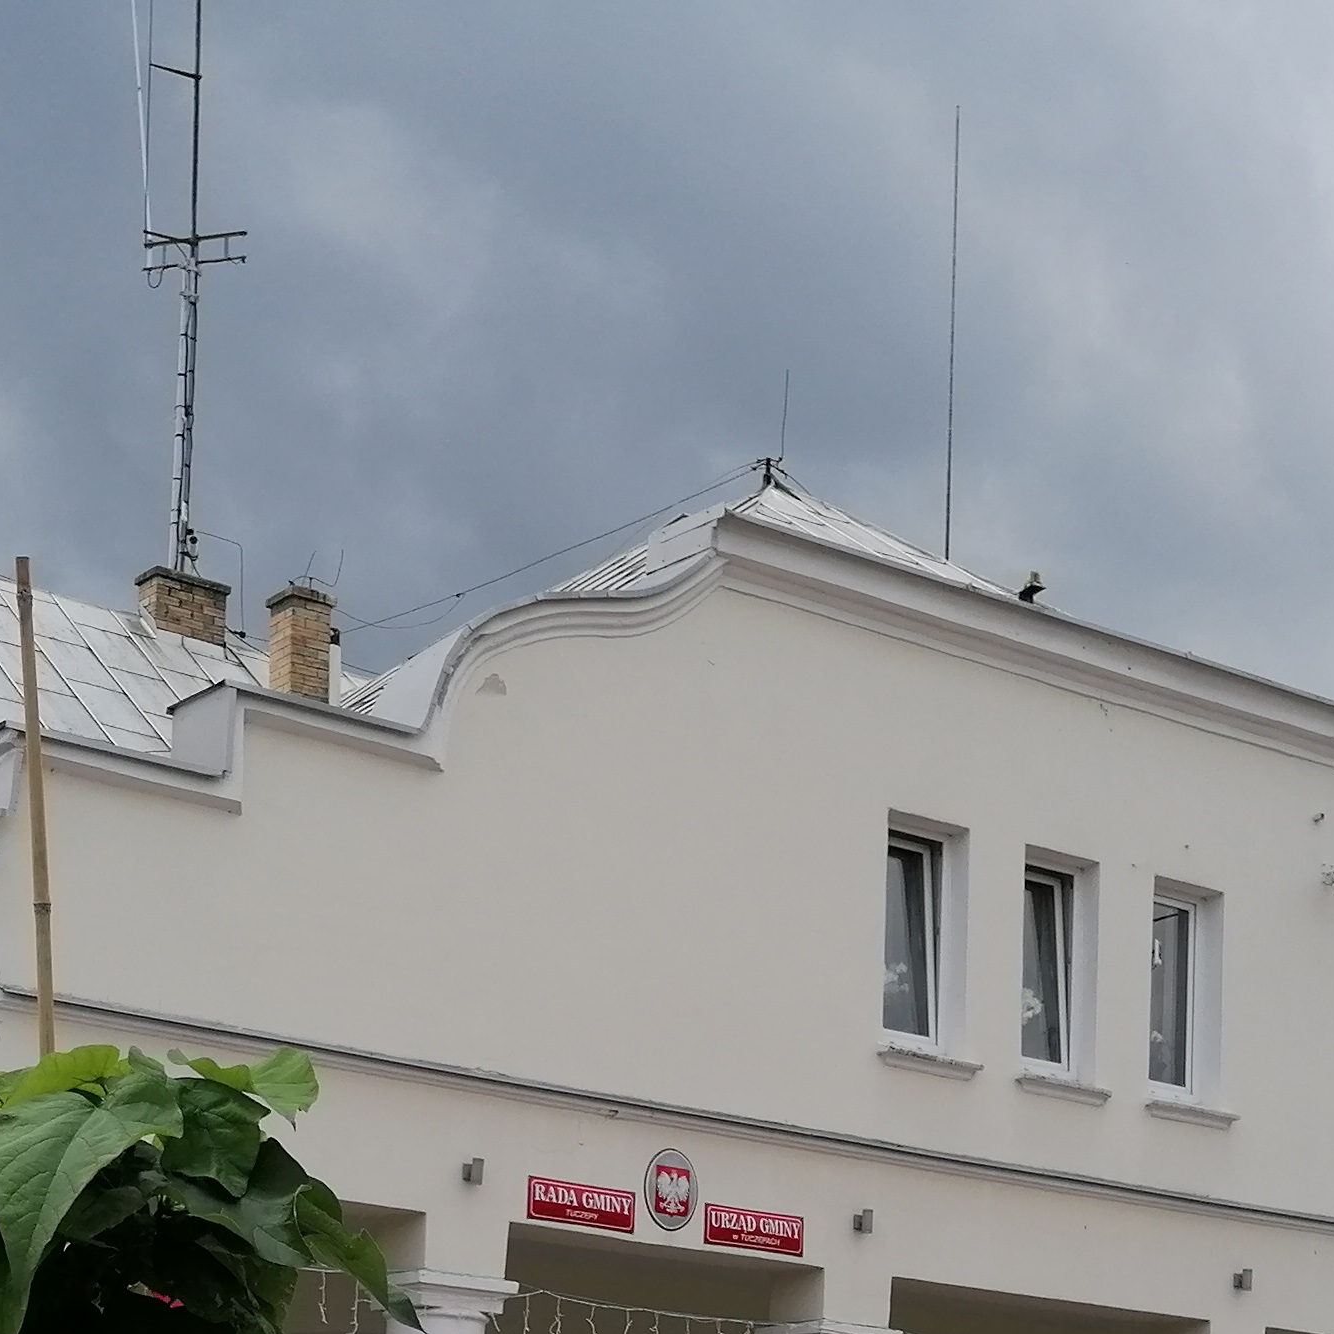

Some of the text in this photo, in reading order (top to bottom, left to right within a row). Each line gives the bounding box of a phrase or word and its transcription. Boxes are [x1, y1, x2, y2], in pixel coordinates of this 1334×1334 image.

[534, 1183, 632, 1216] RADA GMINY
[710, 1210, 801, 1240] URZĄD GMINY
